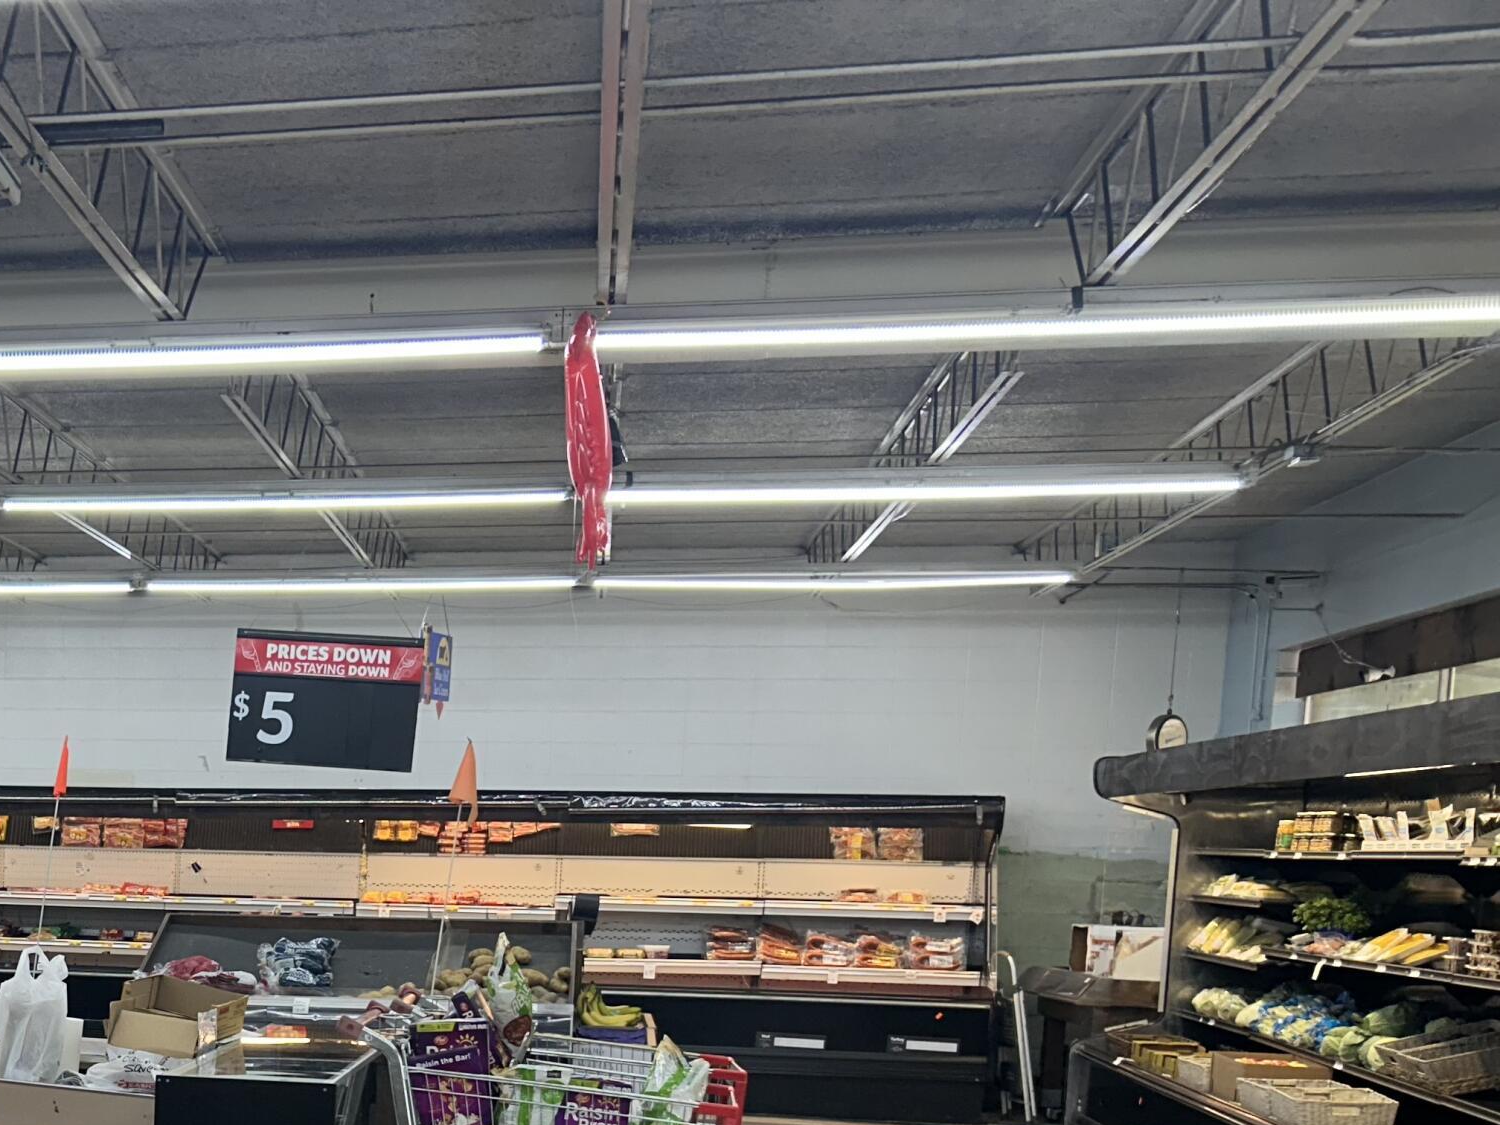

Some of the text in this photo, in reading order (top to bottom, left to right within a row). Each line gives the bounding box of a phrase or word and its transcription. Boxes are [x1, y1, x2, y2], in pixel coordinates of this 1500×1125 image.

[266, 643, 392, 665] PRICES DOWN
[264, 660, 390, 678] AND STAYING DOWN
[256, 691, 295, 745] 5
[440, 1057, 454, 1065] the
[563, 1101, 620, 1121] Raisin
